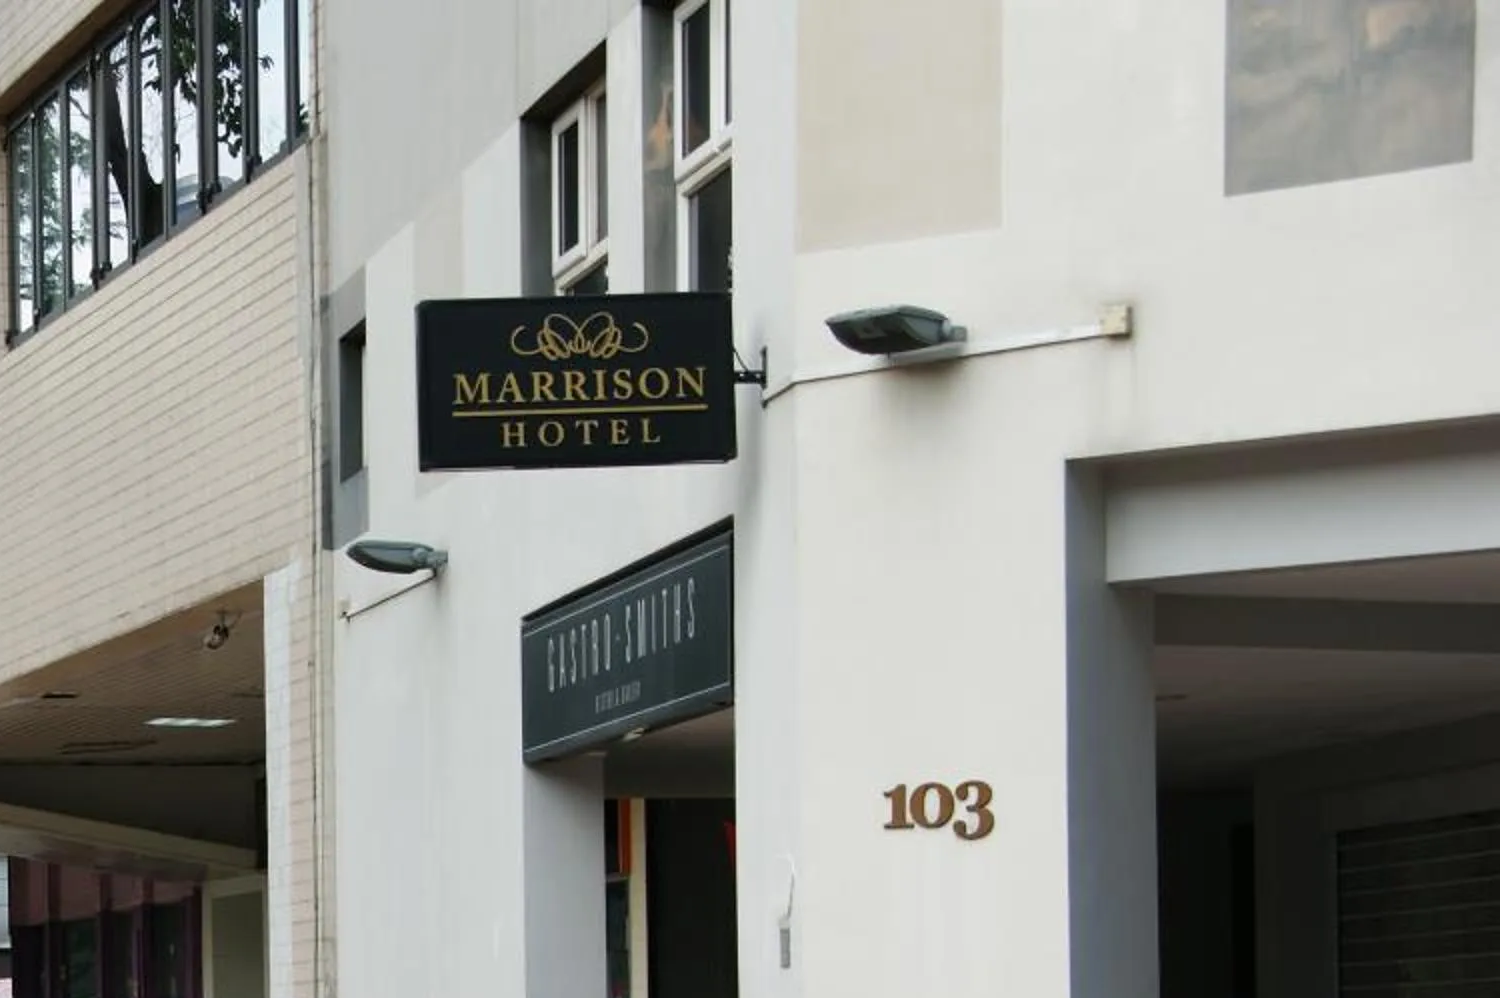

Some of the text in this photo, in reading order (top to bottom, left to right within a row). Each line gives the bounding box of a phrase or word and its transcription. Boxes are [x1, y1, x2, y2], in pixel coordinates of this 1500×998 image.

[452, 366, 707, 405] MARRISON
[502, 418, 661, 448] HOTEL
[883, 780, 996, 841] 103
